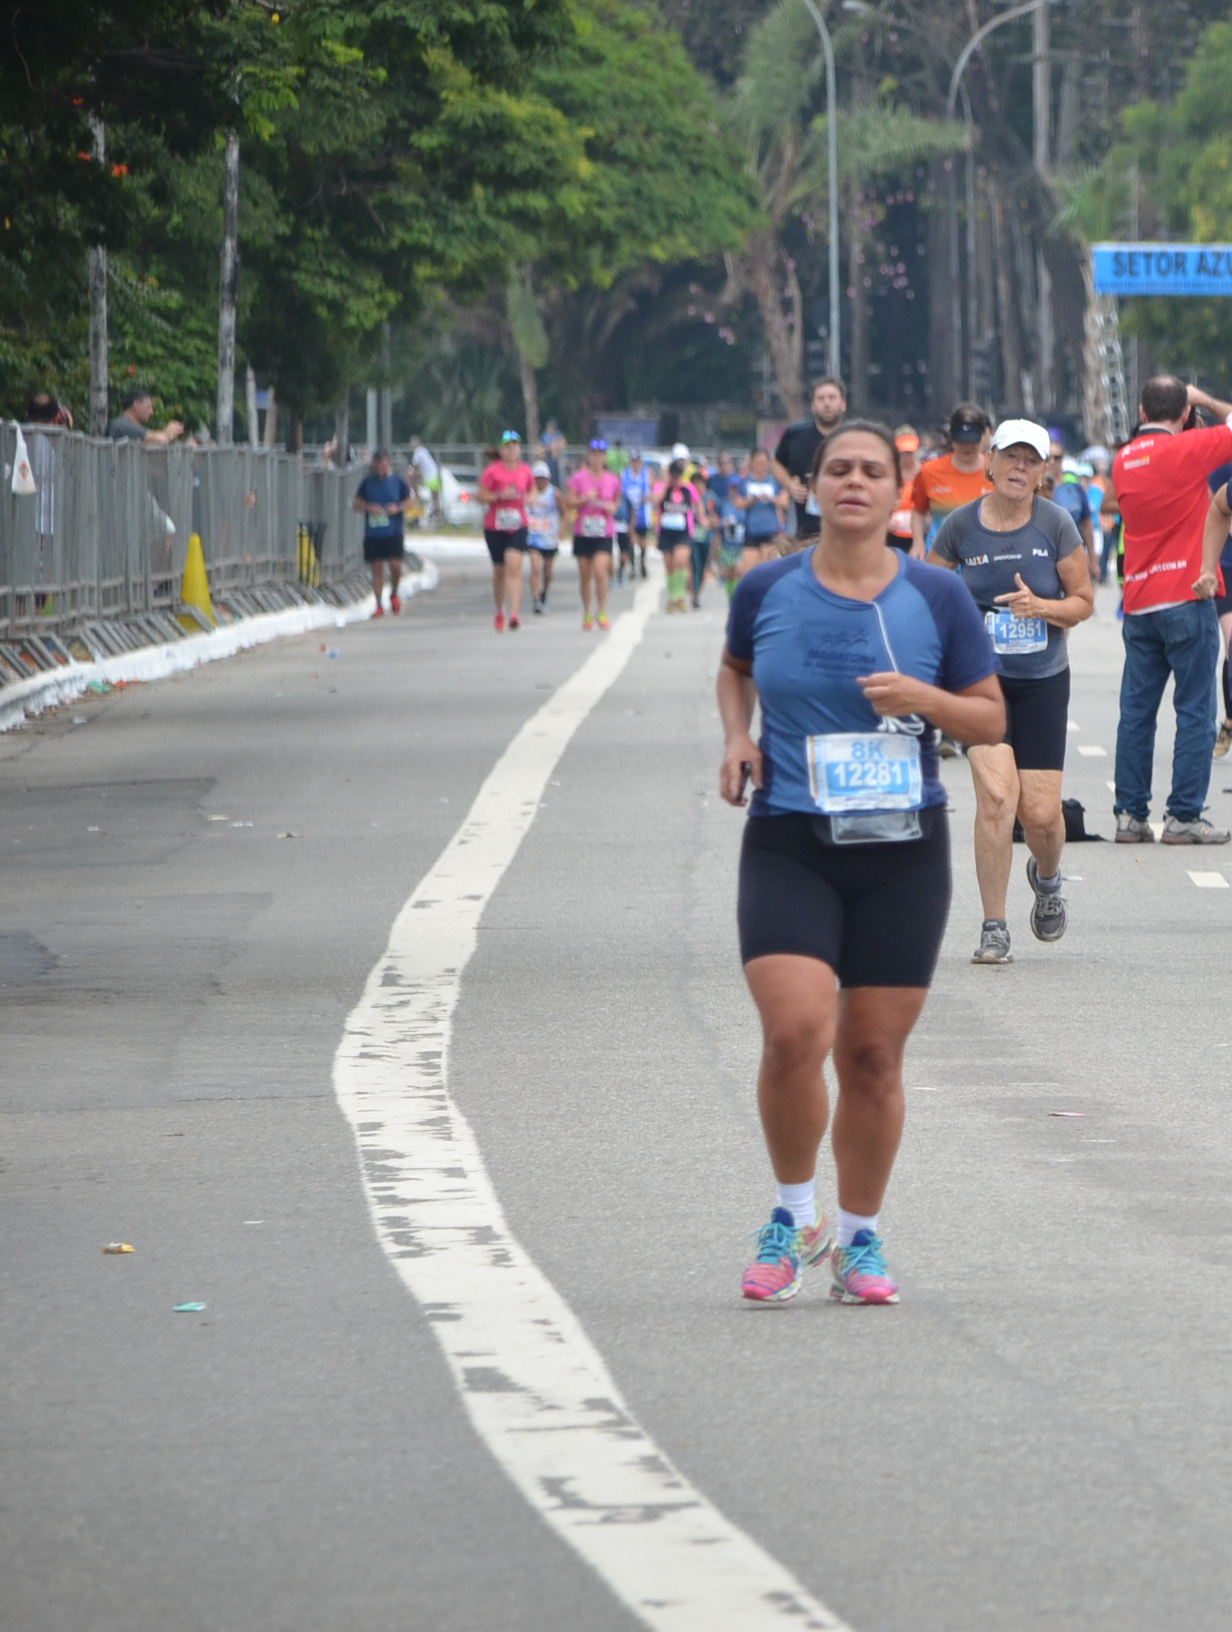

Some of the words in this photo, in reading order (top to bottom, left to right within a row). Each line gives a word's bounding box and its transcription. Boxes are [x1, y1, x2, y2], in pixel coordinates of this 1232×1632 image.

[1113, 251, 1188, 277] SETOR
[1000, 621, 1042, 639] 12951
[851, 741, 885, 760] 8K
[834, 760, 902, 788] 12281
